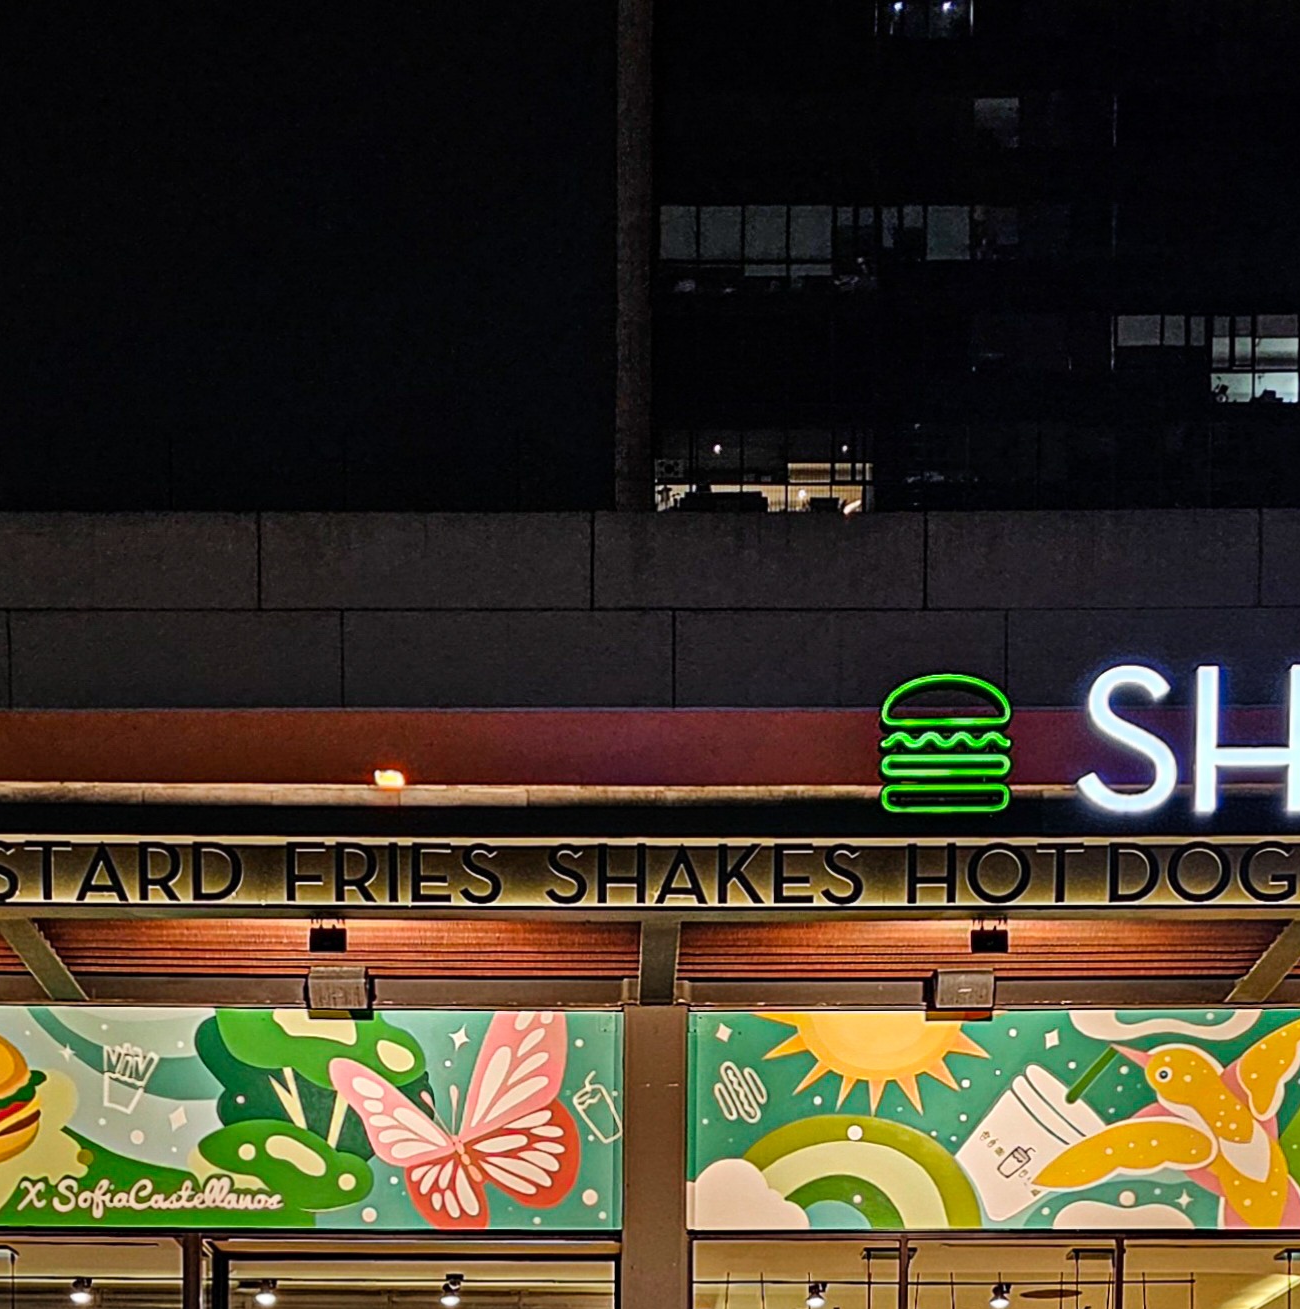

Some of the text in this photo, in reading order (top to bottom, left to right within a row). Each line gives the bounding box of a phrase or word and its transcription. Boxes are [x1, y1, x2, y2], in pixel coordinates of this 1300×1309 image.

[285, 841, 503, 904] FRIES
[545, 841, 864, 905] SHAKES
[906, 841, 1087, 905] HOT
